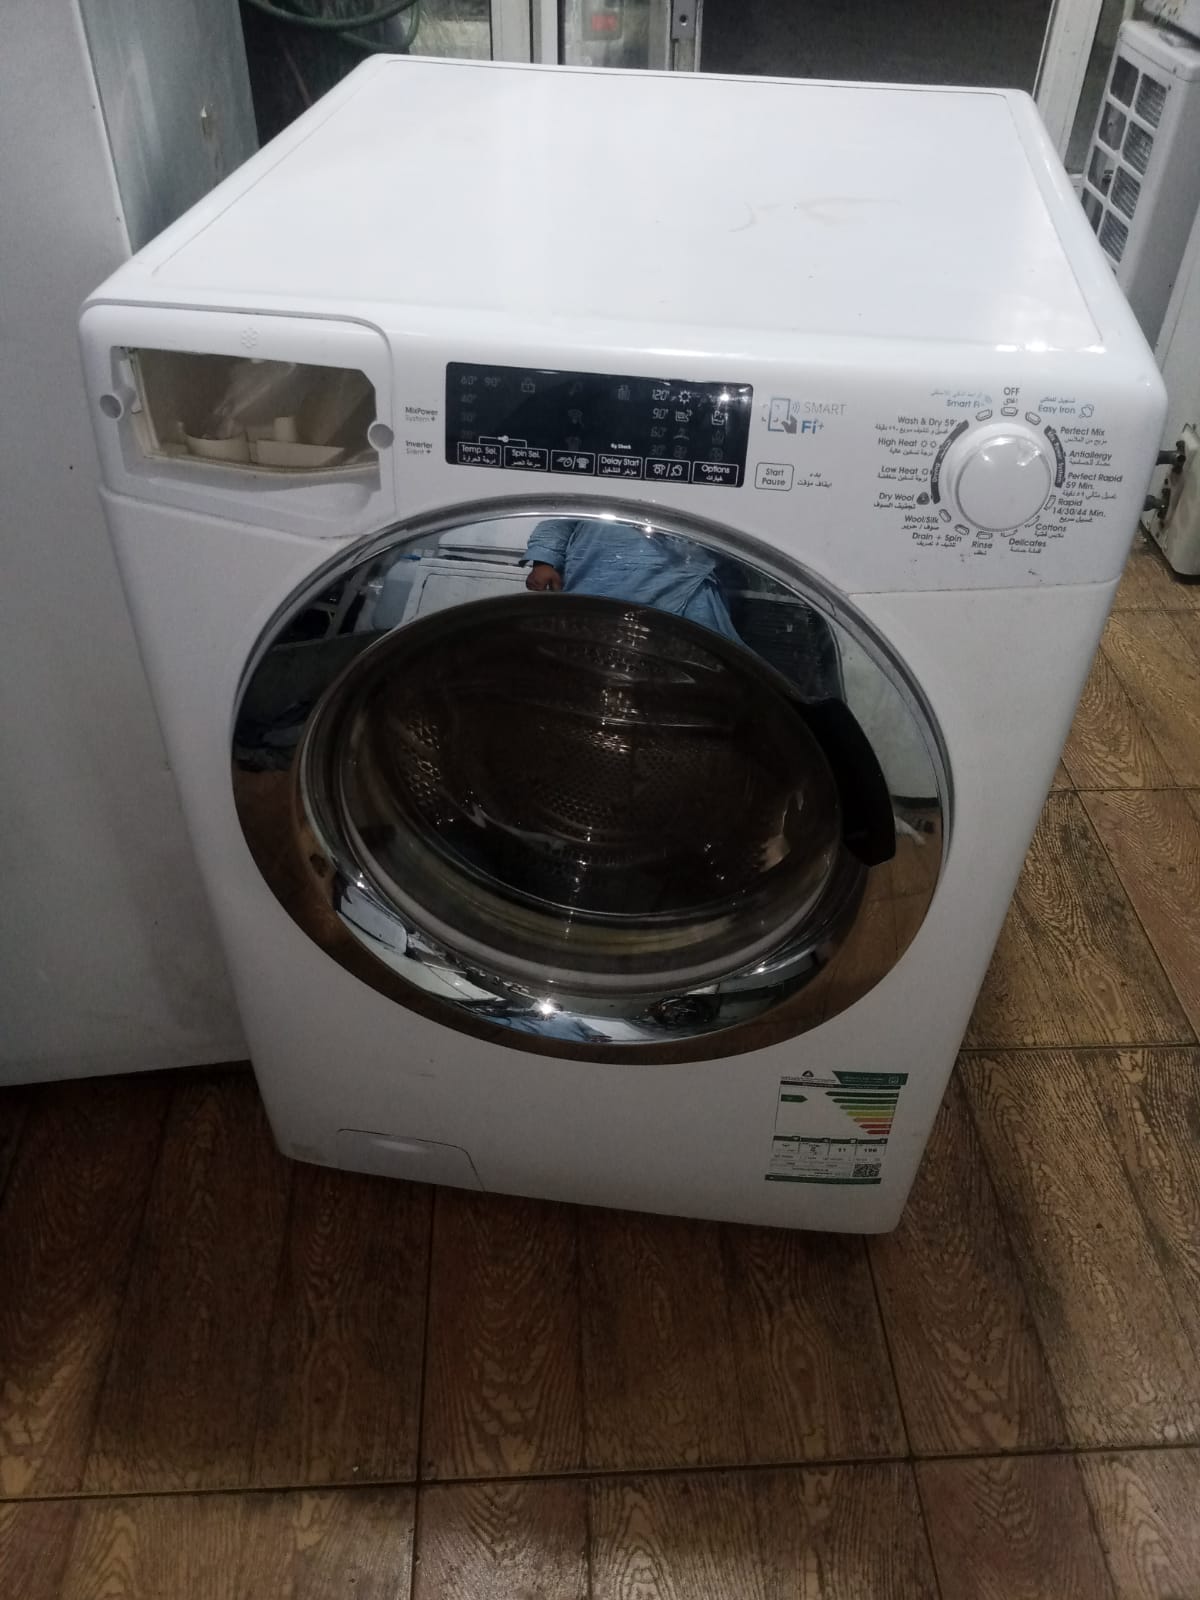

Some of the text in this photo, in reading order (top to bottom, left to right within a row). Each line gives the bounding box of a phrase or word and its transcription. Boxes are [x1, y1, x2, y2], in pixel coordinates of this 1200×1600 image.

[1003, 386, 1020, 396] OFF
[803, 401, 847, 416] SMART
[946, 399, 970, 408] Smart
[405, 406, 438, 415] MixPower
[1038, 404, 1076, 414] Easy Iron
[897, 416, 919, 425] Wash
[920, 418, 926, 426] &
[929, 418, 942, 429] Dry
[1060, 426, 1090, 436] Perfect
[405, 440, 433, 449] Inverter
[878, 437, 917, 448] High Heat
[461, 445, 497, 455] Temp. Sel.
[511, 449, 527, 458] Spin
[1069, 451, 1112, 461] Antiallergy
[601, 456, 640, 467] Delay Start
[701, 464, 731, 474] Options
[766, 468, 785, 477] Start
[881, 465, 918, 475] Low Heat
[761, 477, 787, 486] Pause
[1067, 472, 1123, 483] Perfect Rapid
[1065, 481, 1095, 490] 59 Min.
[878, 492, 914, 502] Dry Wool
[1057, 498, 1083, 507] Rapid
[1088, 509, 1106, 518] Min.
[1034, 522, 1067, 533] Cottons
[911, 532, 934, 541] Drain
[944, 534, 963, 544] Spin
[1008, 537, 1047, 548] Delicates
[971, 540, 993, 549] Rinse
